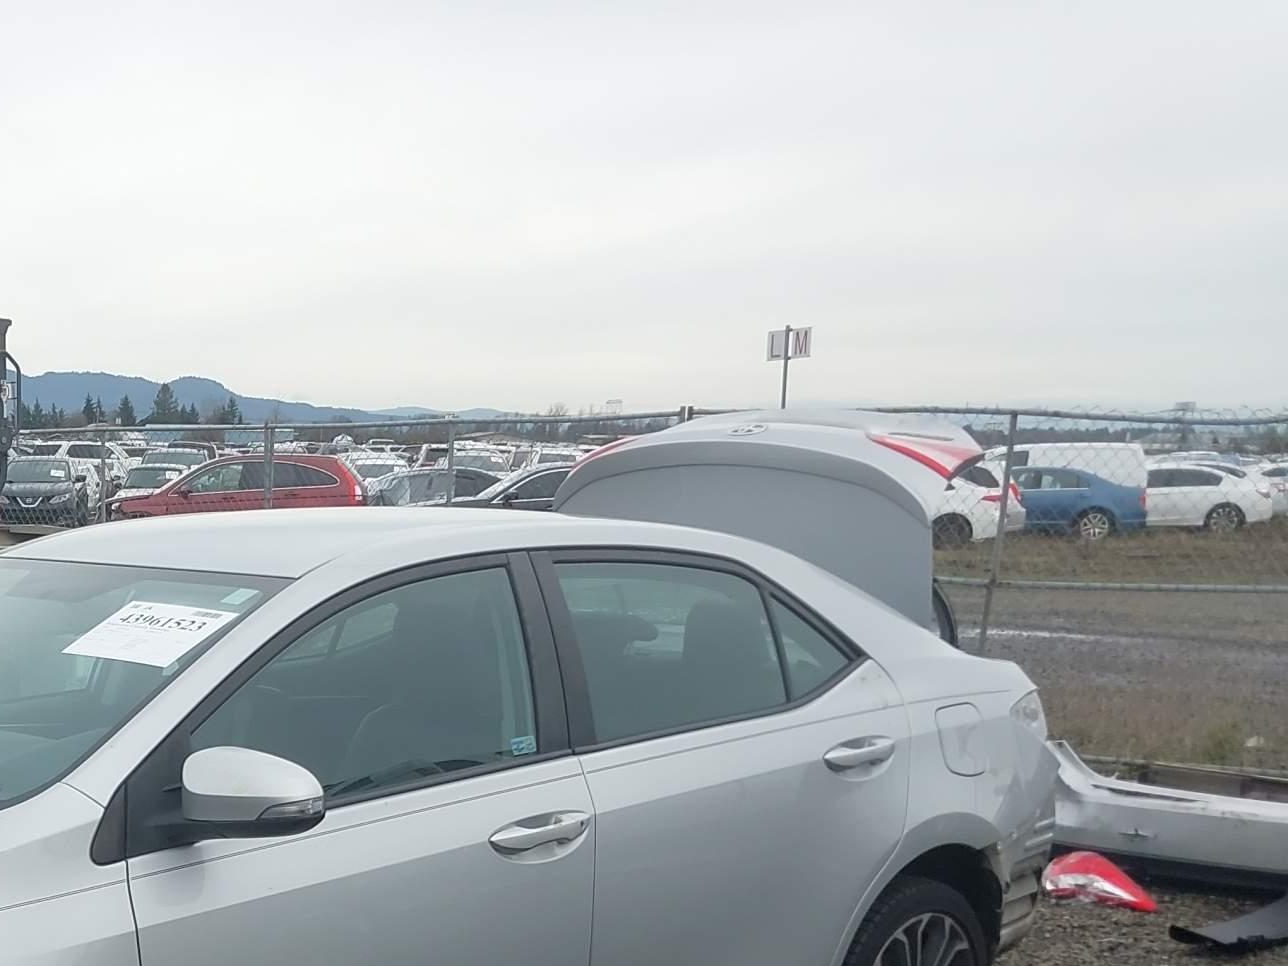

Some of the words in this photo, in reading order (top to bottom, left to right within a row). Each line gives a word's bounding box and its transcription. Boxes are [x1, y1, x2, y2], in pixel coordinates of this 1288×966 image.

[770, 333, 782, 358] L
[794, 329, 808, 355] M
[119, 612, 208, 632] 43961523
